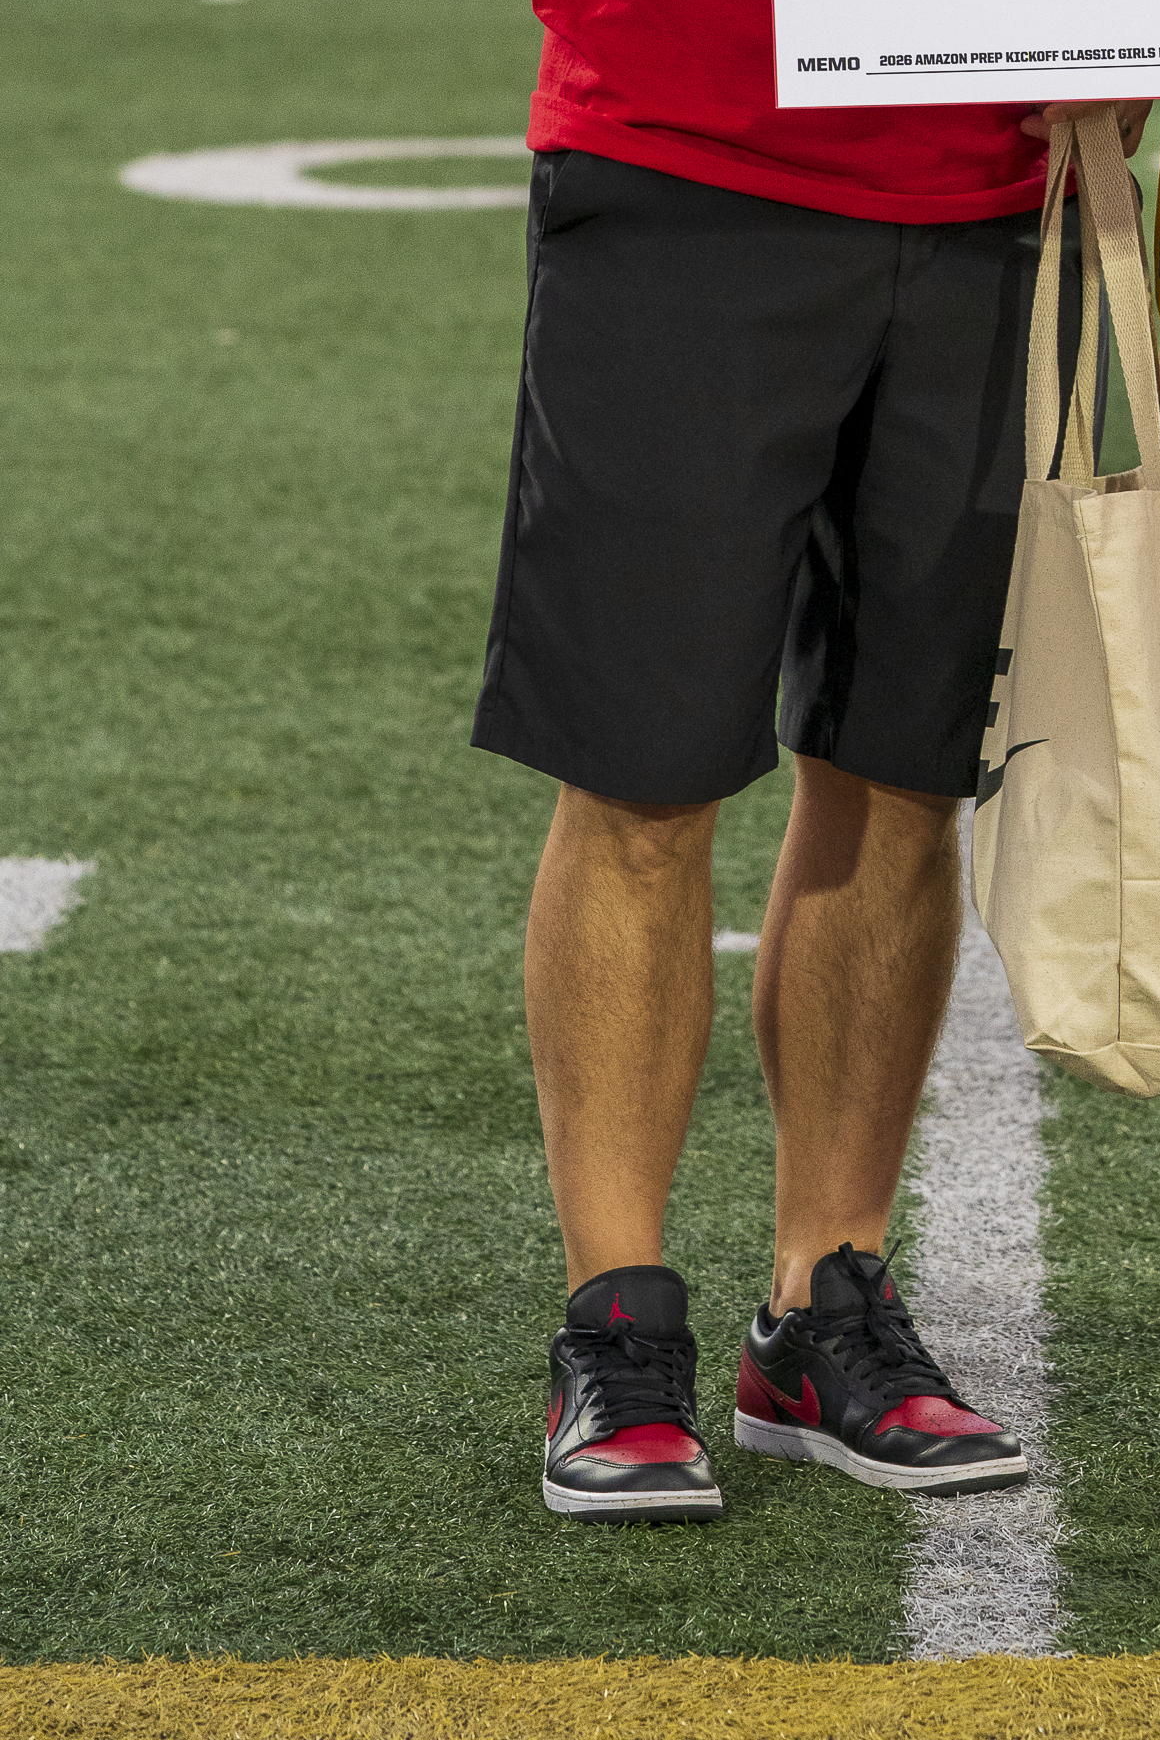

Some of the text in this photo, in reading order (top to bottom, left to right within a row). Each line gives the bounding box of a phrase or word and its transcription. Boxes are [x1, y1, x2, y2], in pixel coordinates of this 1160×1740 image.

[797, 57, 861, 72] MEMO
[880, 55, 913, 67] 2026
[915, 53, 968, 66] AMAZON
[970, 52, 1003, 64] PREP
[1005, 50, 1059, 63] KICKOFF
[1061, 48, 1116, 61] CLASSIC
[1118, 47, 1156, 60] GIRLS
